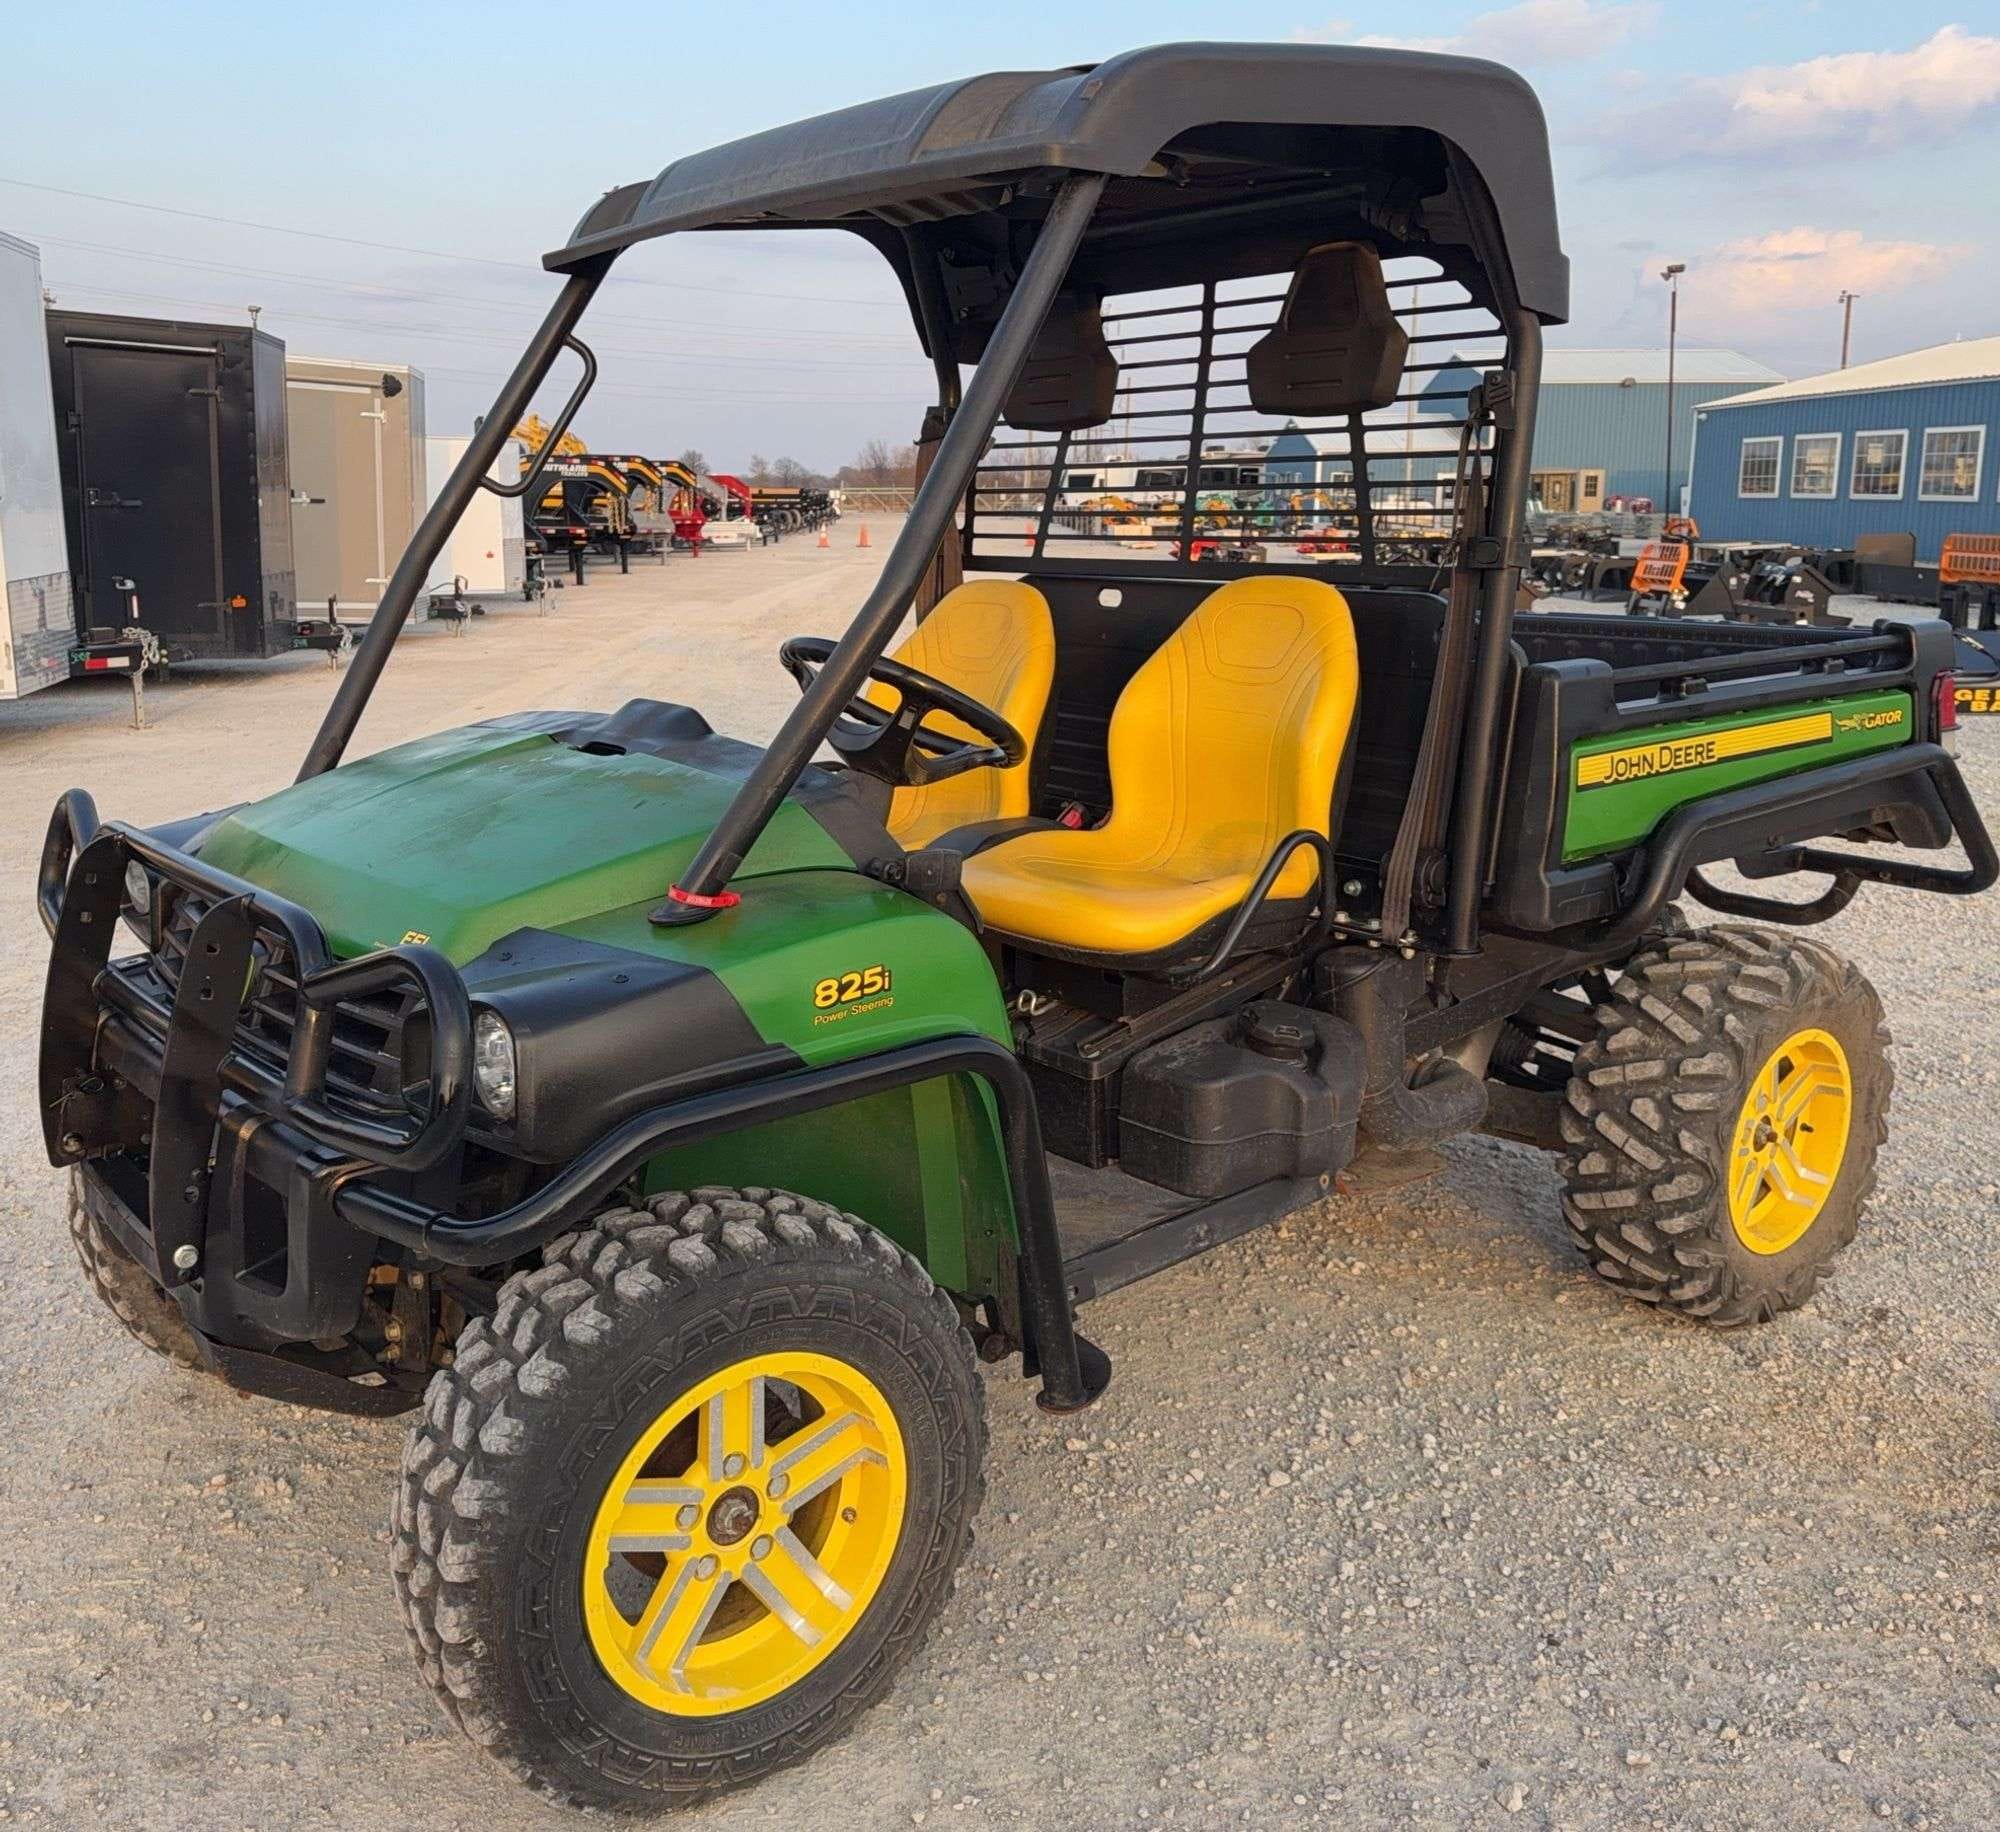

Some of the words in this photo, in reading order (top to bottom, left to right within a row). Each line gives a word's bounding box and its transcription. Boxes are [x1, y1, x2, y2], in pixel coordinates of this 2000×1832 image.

[1865, 710, 1902, 728] GATOR
[1604, 752, 1654, 780] JOHN
[1659, 741, 1716, 769] DEERE
[814, 965, 890, 1008] 825i
[814, 1009, 848, 1026] Power
[851, 997, 894, 1015] Steering
